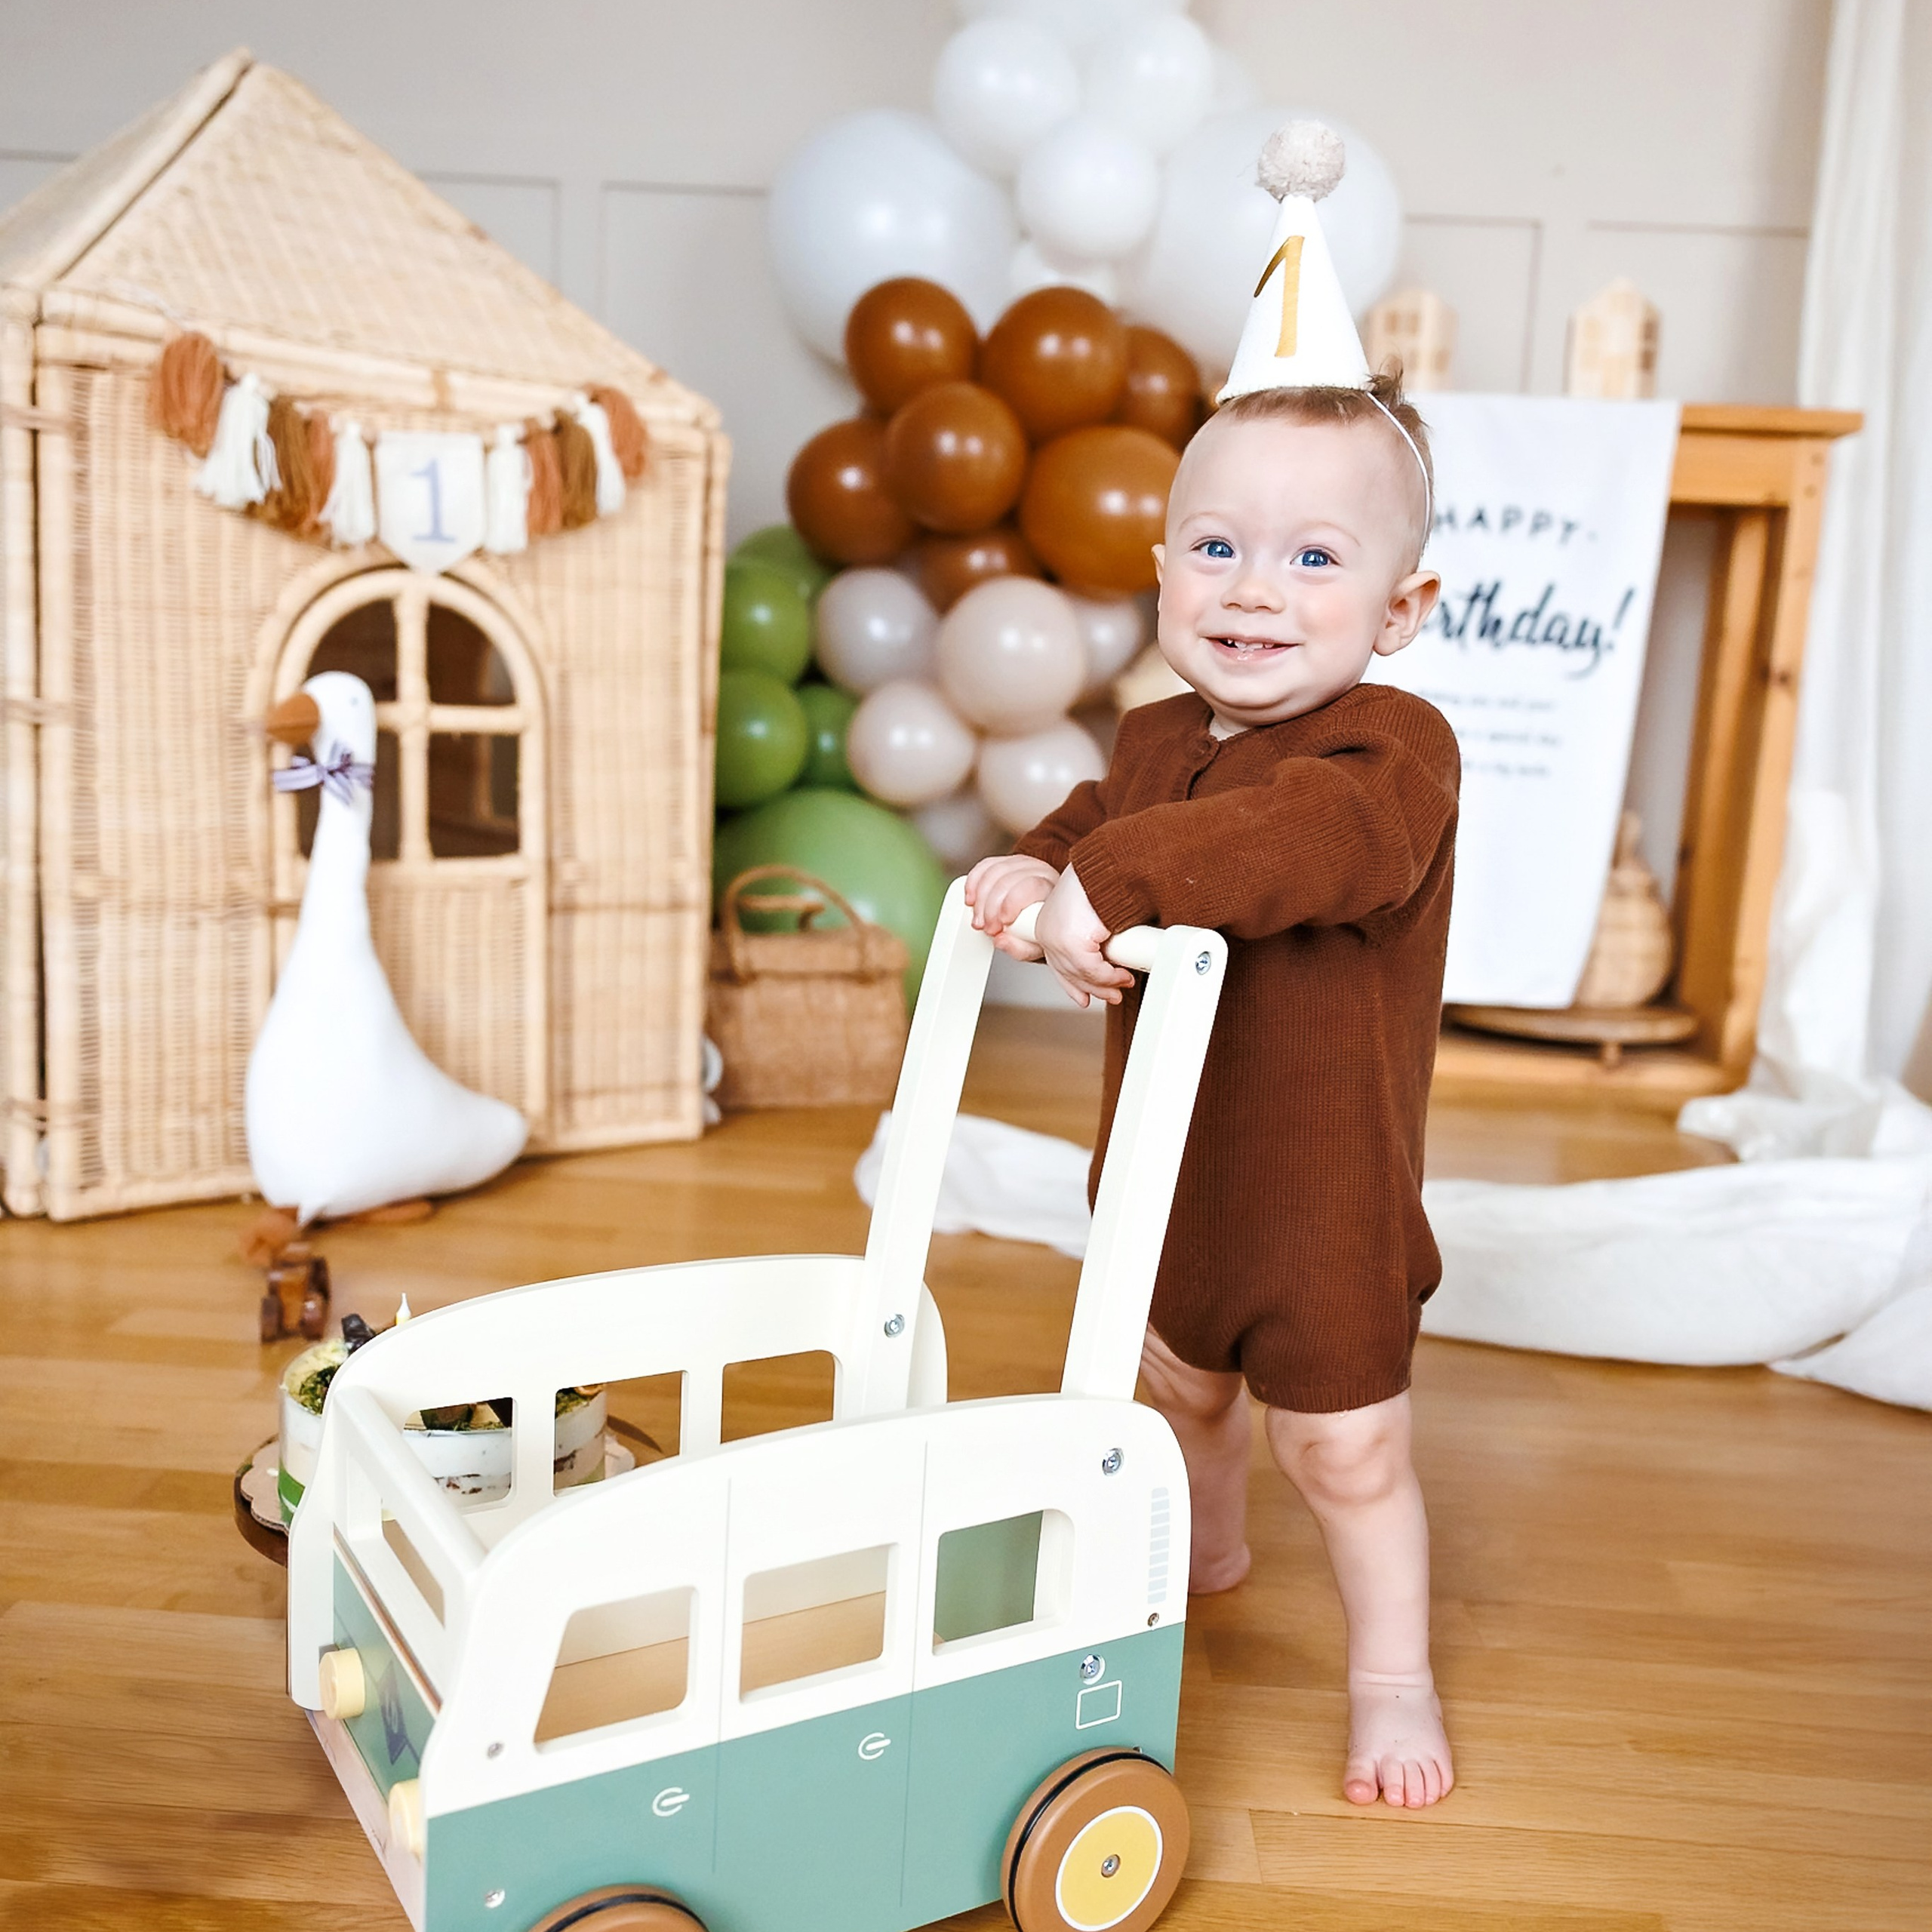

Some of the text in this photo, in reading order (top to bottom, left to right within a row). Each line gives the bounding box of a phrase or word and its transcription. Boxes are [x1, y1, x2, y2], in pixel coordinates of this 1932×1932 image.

[1254, 235, 1305, 358] 1
[411, 457, 457, 544] 1
[1423, 580, 1636, 680] rthday!
